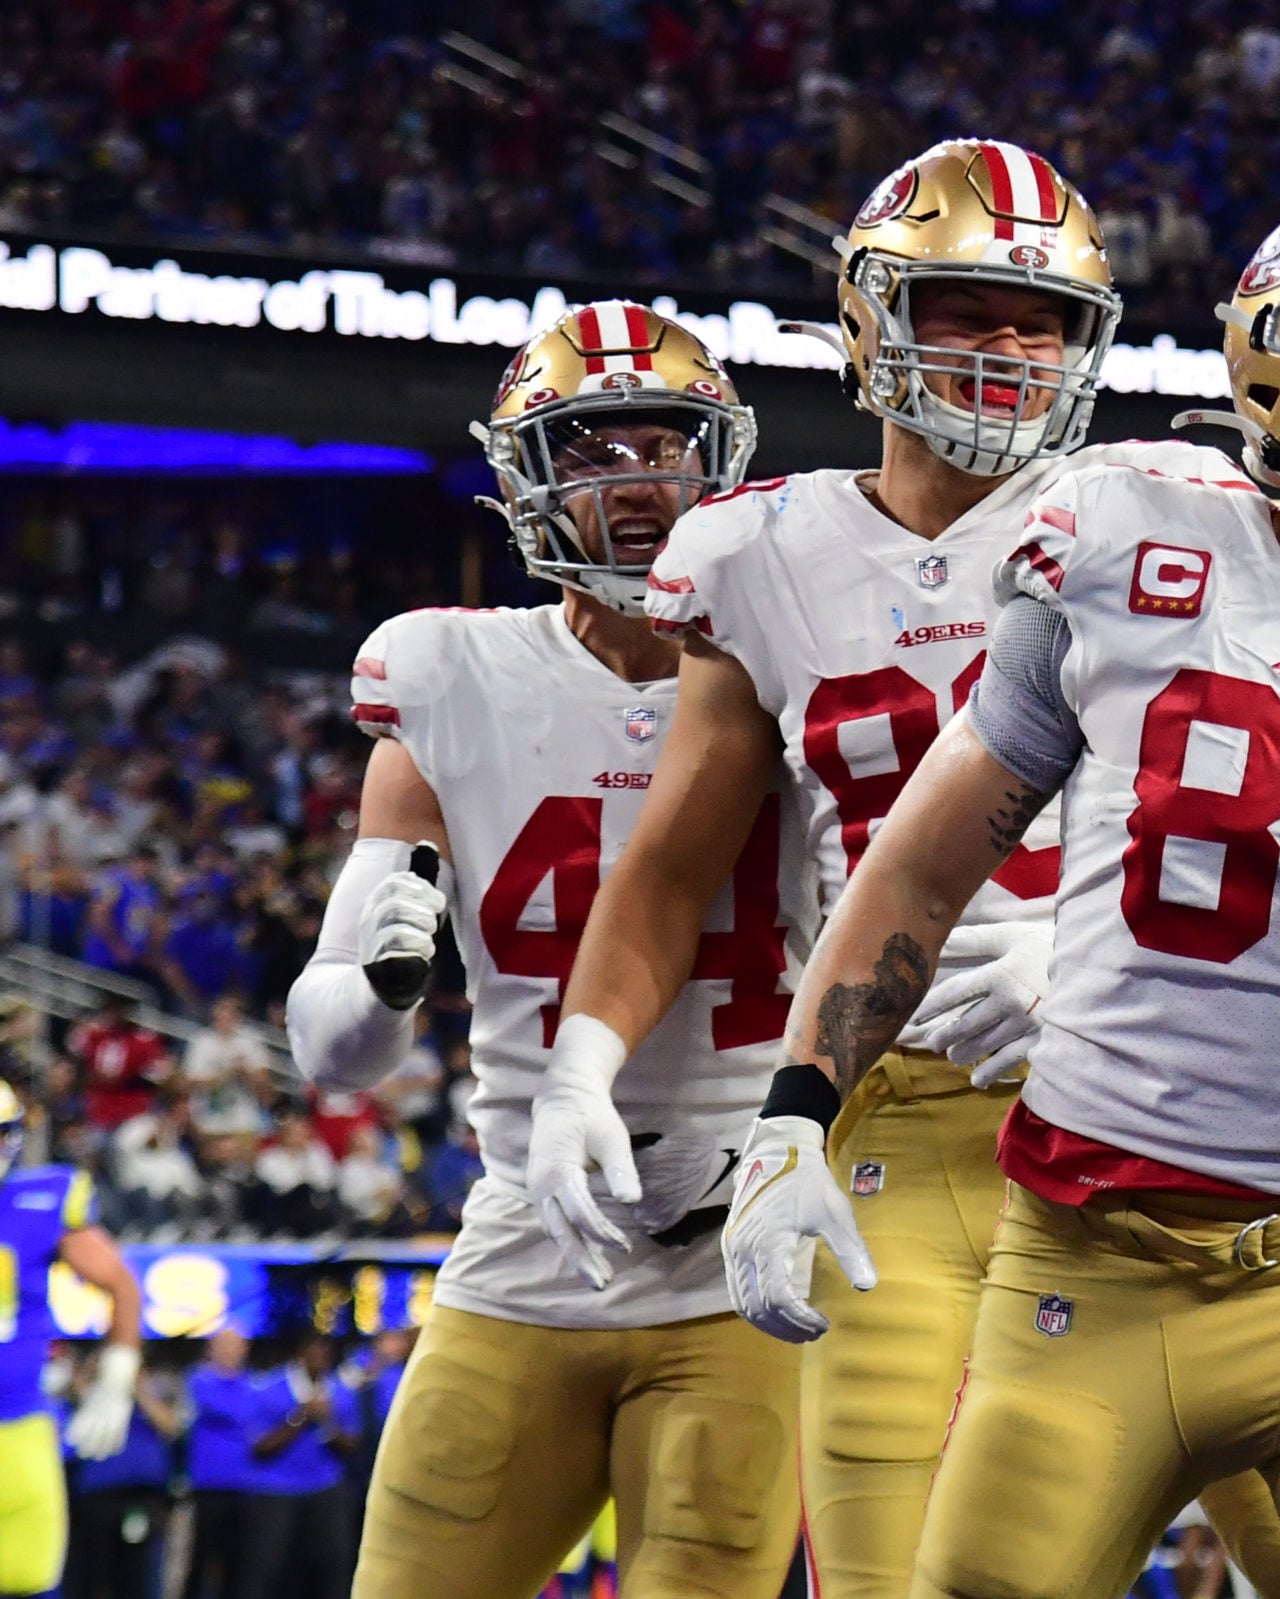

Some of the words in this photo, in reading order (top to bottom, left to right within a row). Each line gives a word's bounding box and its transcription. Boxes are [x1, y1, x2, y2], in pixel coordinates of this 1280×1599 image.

[59, 247, 268, 328] Partner
[263, 270, 331, 333] of
[328, 270, 428, 341] The
[1139, 548, 1204, 599] C
[896, 621, 986, 647] 49ERS
[1077, 1175, 1115, 1188] DRI-FIT
[1041, 1311, 1064, 1330] NFL
